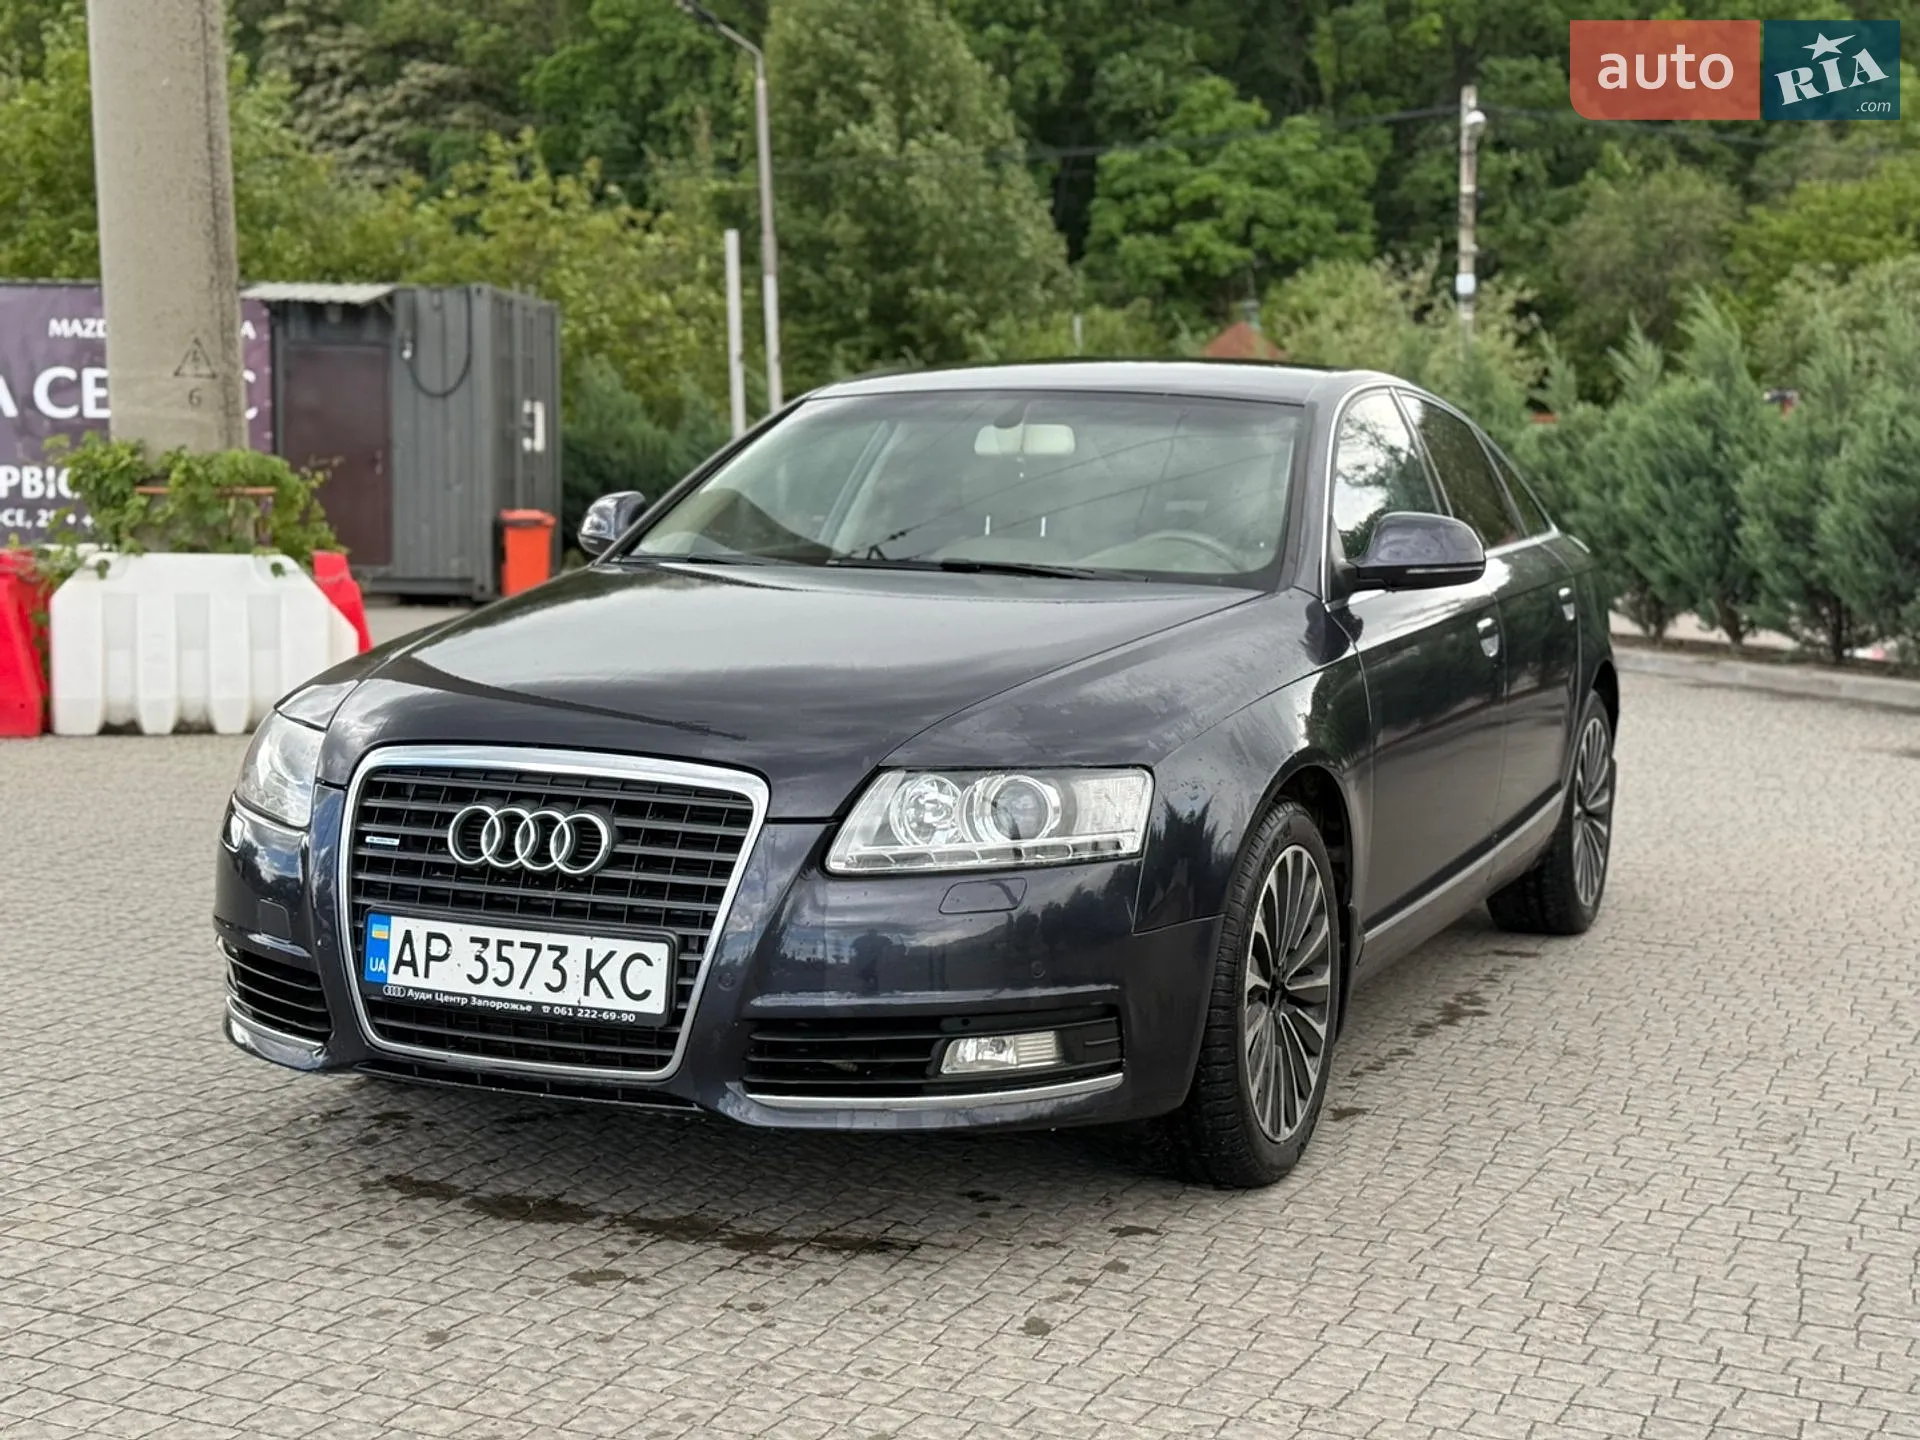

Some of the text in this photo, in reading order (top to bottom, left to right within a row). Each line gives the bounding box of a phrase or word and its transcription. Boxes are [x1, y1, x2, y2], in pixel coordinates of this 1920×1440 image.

[369, 957, 387, 974] UA
[391, 929, 655, 1002] AP 3573 KC
[406, 988, 637, 1023] Ауди Центр Запорожье 061 222-69-90
